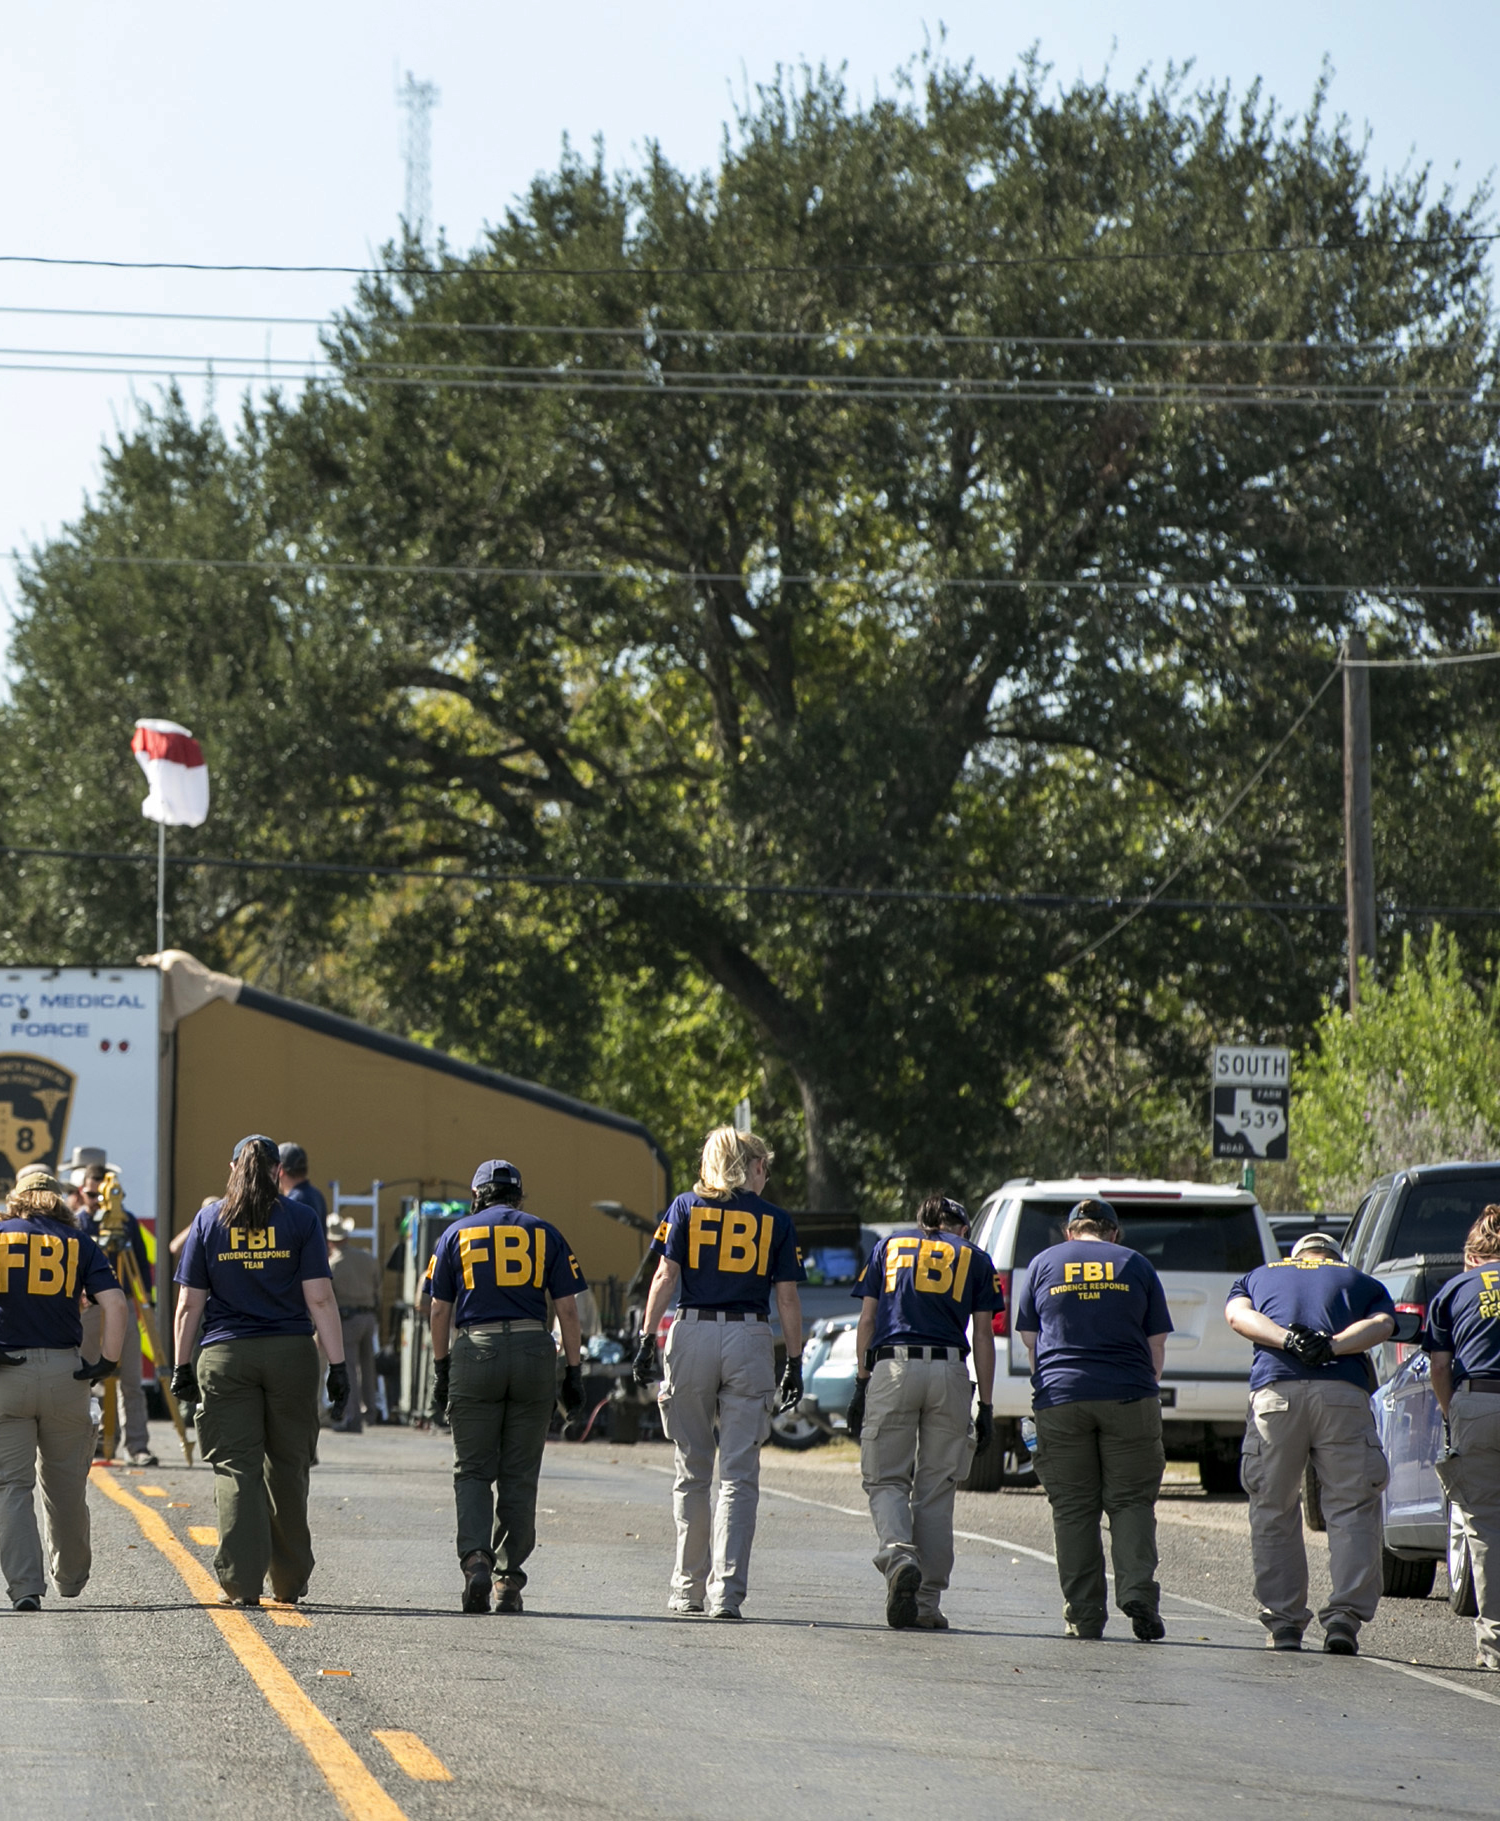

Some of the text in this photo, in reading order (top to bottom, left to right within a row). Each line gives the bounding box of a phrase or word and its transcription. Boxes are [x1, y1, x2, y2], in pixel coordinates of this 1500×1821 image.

[39, 993, 146, 1009] MEDICAL
[10, 1021, 90, 1038] FORCE
[1218, 1054, 1286, 1077] SOUTH
[1257, 1089, 1282, 1099] FARM
[1240, 1110, 1279, 1129] 539
[17, 1126, 34, 1153] 8
[1219, 1142, 1244, 1154] ROAD
[230, 1226, 276, 1250] FBI
[688, 1206, 774, 1276] FBI
[218, 1250, 290, 1262] EVIDENCE RESPONSE
[243, 1261, 264, 1269] TEAM
[459, 1225, 546, 1290] FBI
[884, 1236, 972, 1303] FBI
[1064, 1261, 1114, 1283] FBI
[1050, 1282, 1130, 1296] EVIDENCE RESPONSE
[1078, 1291, 1100, 1300] TEAM
